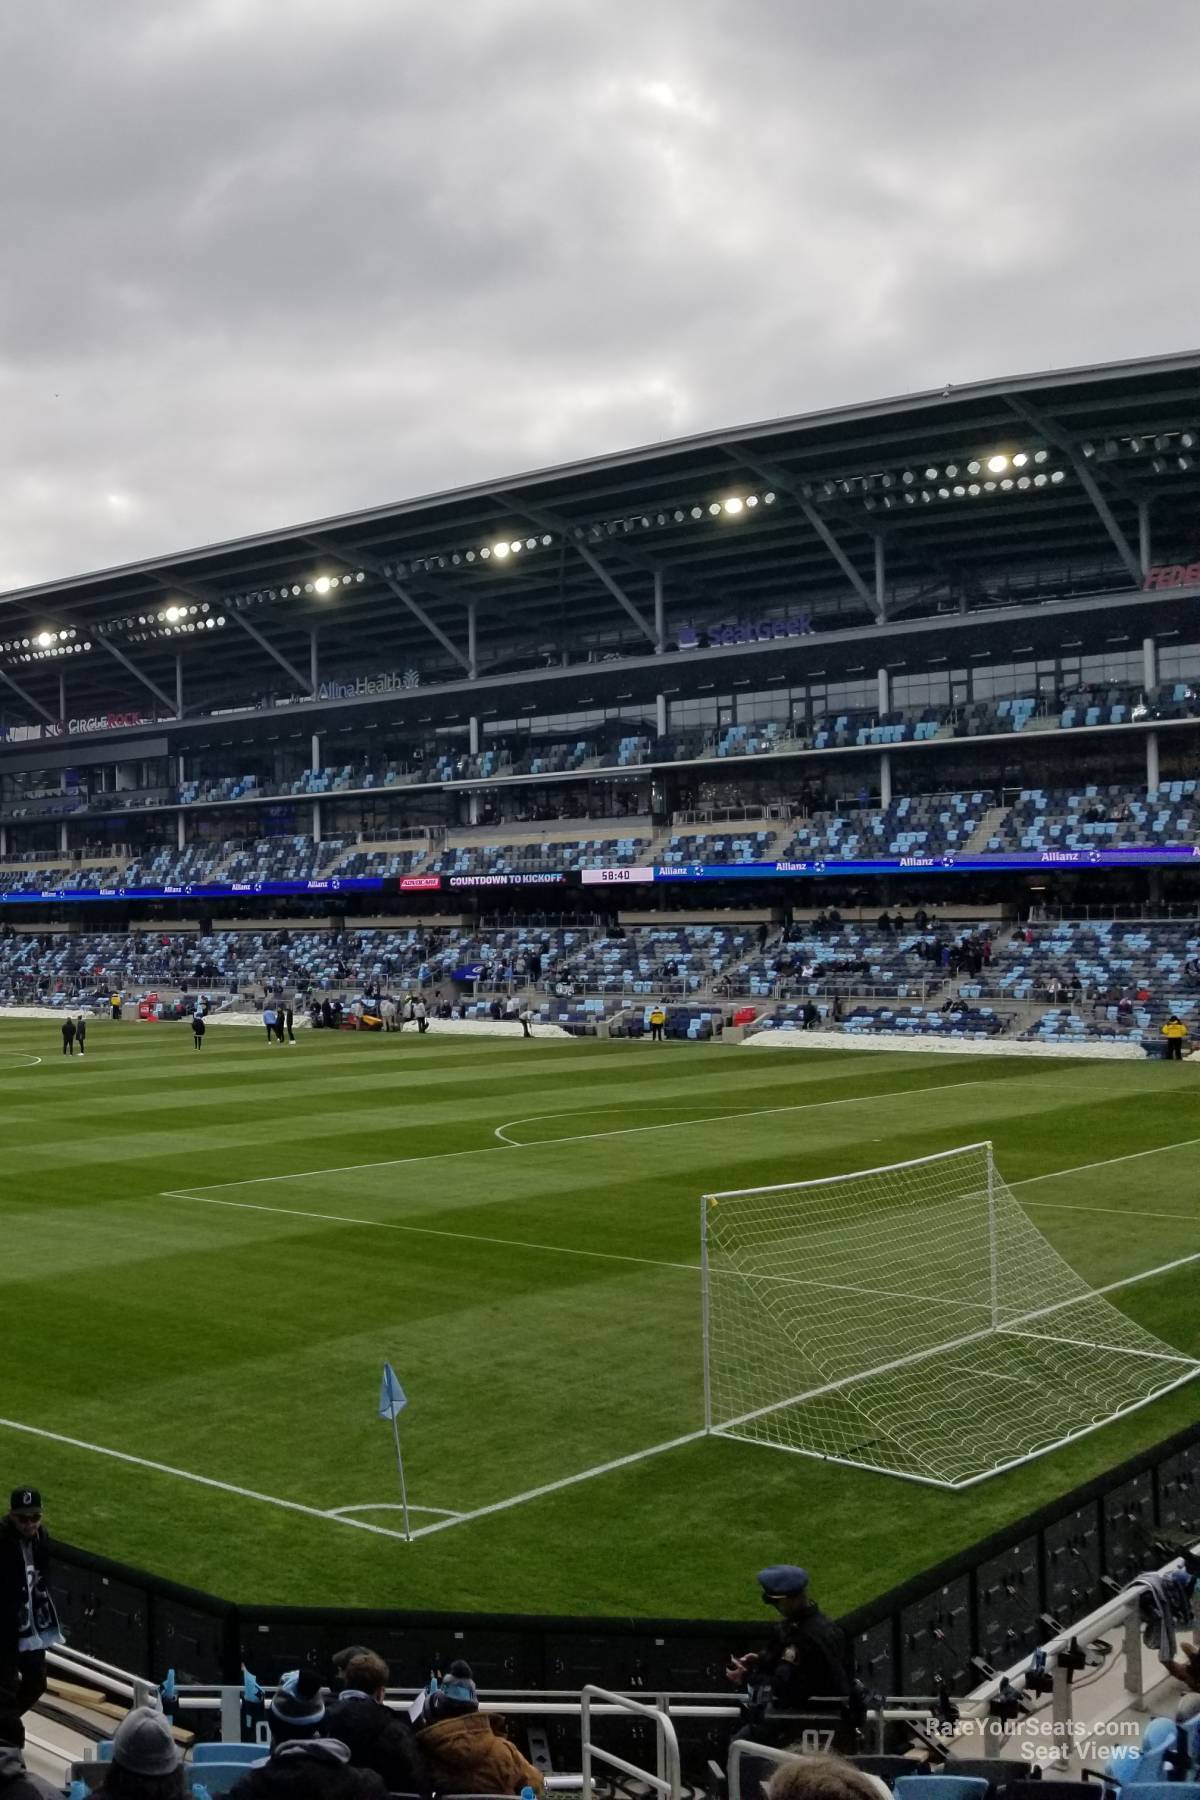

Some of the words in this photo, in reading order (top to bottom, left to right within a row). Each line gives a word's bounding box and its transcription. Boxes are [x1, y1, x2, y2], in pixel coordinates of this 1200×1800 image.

[708, 614, 811, 645] SeatGeek
[1041, 852, 1078, 861] Allianz
[900, 857, 933, 866] Allianz
[659, 866, 687, 875] Allianz
[776, 862, 806, 871] Allianz
[602, 871, 630, 880] 58:40
[308, 880, 328, 888] Allianz
[450, 876, 507, 886] COUNTDOWN
[509, 875, 521, 884] TO
[802, 1729, 835, 1753] 07
